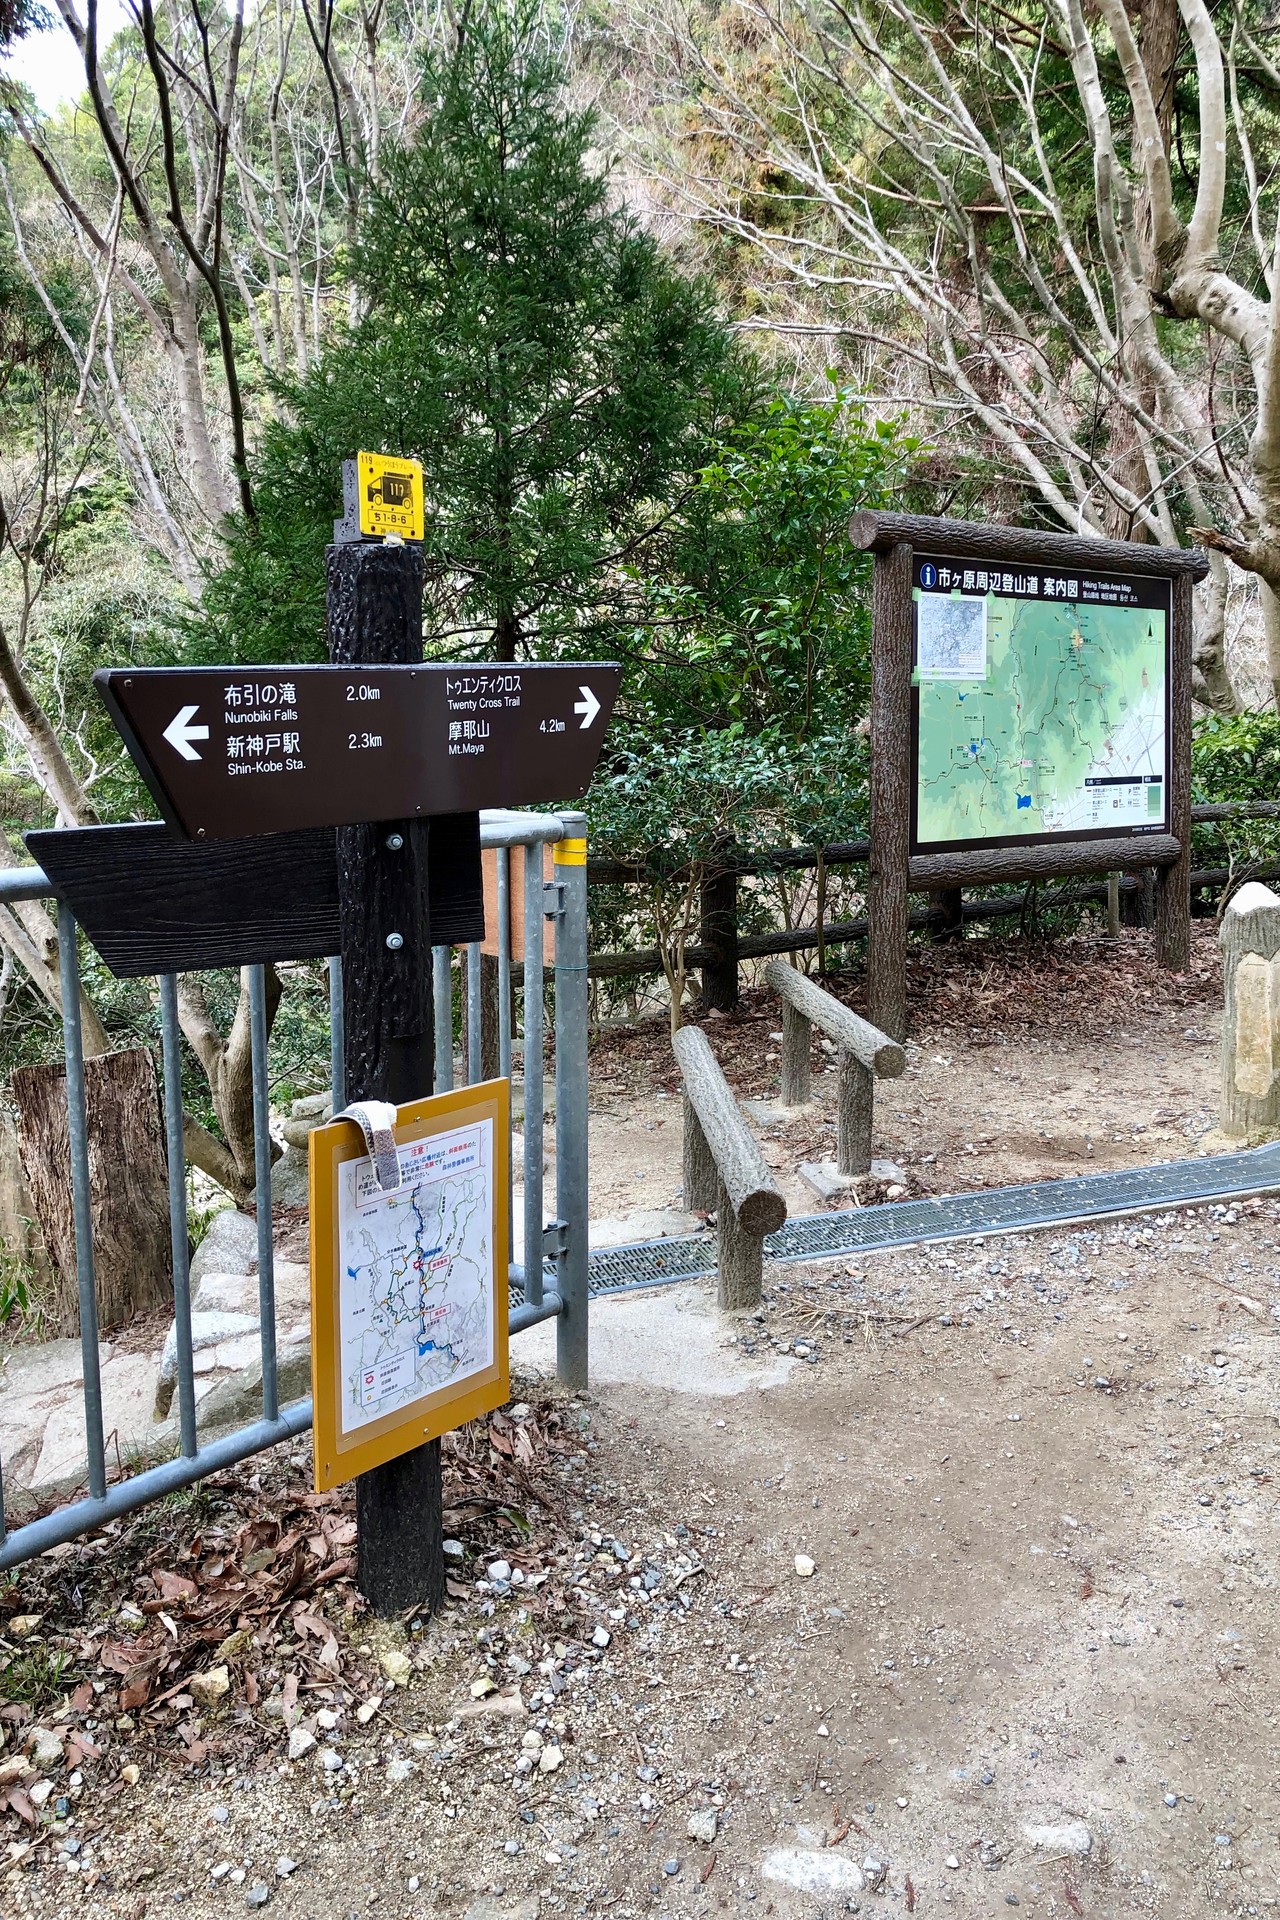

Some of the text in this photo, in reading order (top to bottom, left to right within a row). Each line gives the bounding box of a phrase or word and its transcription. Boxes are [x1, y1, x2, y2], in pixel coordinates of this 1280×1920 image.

[361, 455, 373, 465] 119
[1043, 577, 1079, 598] 案内図
[1082, 580, 1132, 593] Hiking Trails Area Map
[223, 682, 381, 707] 布引の滝 2.0km
[447, 696, 521, 712] Twenty Cross Trail
[224, 709, 298, 724] Nunobiki Falls
[448, 719, 566, 741] 摩耶山 4.2km
[226, 732, 383, 758] 新神戸駅 2.3km
[227, 758, 306, 776] Shin-Kobe Sta.
